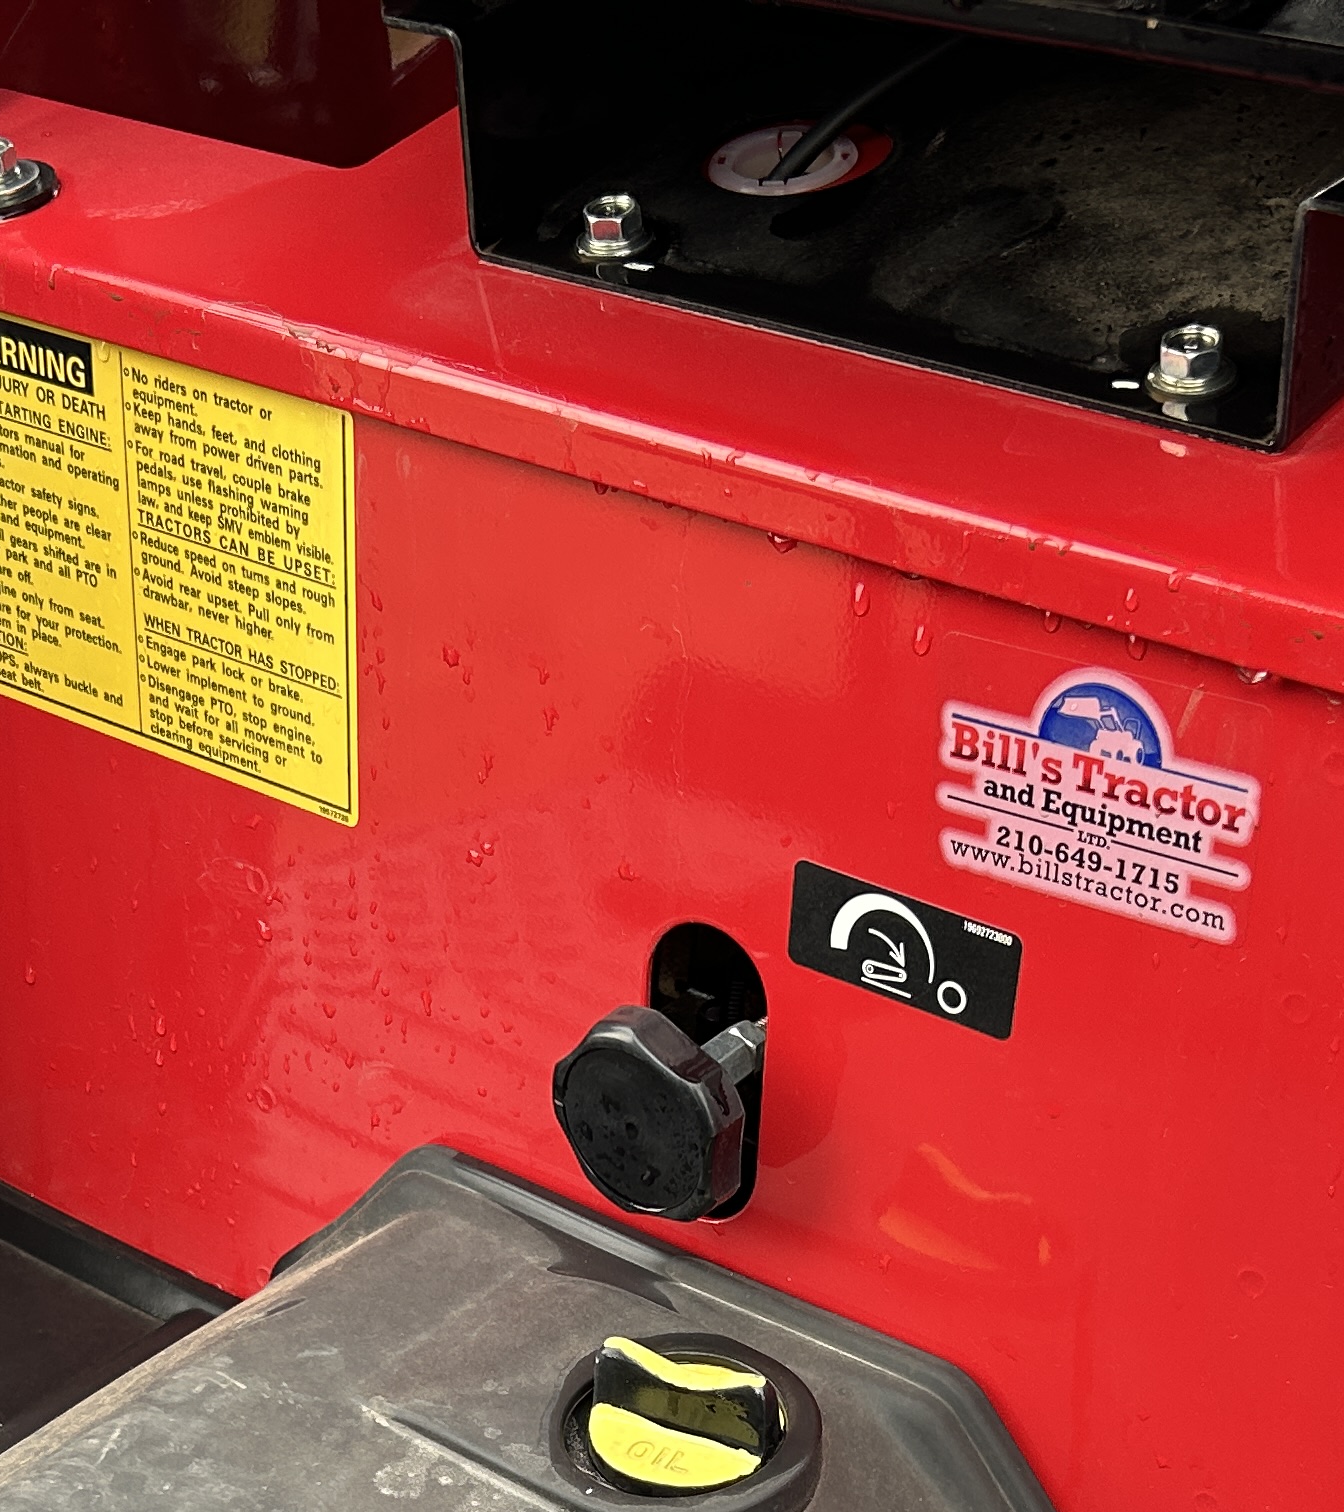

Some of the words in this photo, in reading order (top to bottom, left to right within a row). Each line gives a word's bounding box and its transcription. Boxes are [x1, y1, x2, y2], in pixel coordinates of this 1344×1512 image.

[35, 386, 55, 406] OR
[61, 392, 106, 421] DEATH
[131, 367, 148, 385] No
[153, 374, 187, 397] riders
[192, 388, 207, 403] on
[212, 391, 253, 415] tractor
[259, 407, 272, 420] or
[24, 433, 64, 455] manual
[69, 444, 85, 461] for
[57, 418, 111, 447] ENGINE:
[133, 403, 161, 425] Keep
[243, 437, 266, 454] and
[271, 443, 320, 473] clothing
[22, 503, 58, 525] people
[63, 517, 80, 531] are
[85, 522, 111, 541] clear
[30, 487, 62, 509] safety
[137, 508, 211, 544] TRACTORS
[219, 534, 249, 557] CAN
[257, 546, 275, 565] BE
[283, 554, 335, 584] UPSET:
[139, 531, 179, 556] Reduce
[183, 548, 216, 572] speed
[221, 561, 236, 575] on
[240, 565, 270, 586] turns
[275, 578, 296, 595] and
[302, 586, 335, 608] rough
[15, 605, 31, 621] for
[35, 614, 59, 631] your
[15, 620, 26, 635] in
[21, 591, 44, 611] only
[48, 597, 74, 618] from
[143, 612, 180, 637] WHEN
[185, 626, 242, 659] TRACTOR
[247, 647, 273, 669] HAS
[279, 659, 339, 690] STOPPED:
[145, 635, 186, 662] Engage
[191, 654, 216, 672] park
[221, 662, 245, 682] lock
[250, 675, 263, 688] or
[23, 660, 59, 684] always
[63, 673, 98, 697] buckle
[103, 691, 123, 707] and
[146, 655, 181, 678] Lower
[186, 669, 247, 703] implement
[252, 693, 264, 708] to
[147, 674, 205, 707] Disengage
[210, 696, 236, 718] PTO,
[242, 711, 267, 731] stop
[949, 720, 1063, 785] Bill's
[1071, 755, 1247, 835] Tractor
[984, 778, 1034, 812] and
[1041, 791, 1202, 854] Equipment
[1077, 830, 1111, 850] LTD.
[950, 838, 1226, 931] www.billstractor.com
[996, 826, 1180, 896] 210-649-1715
